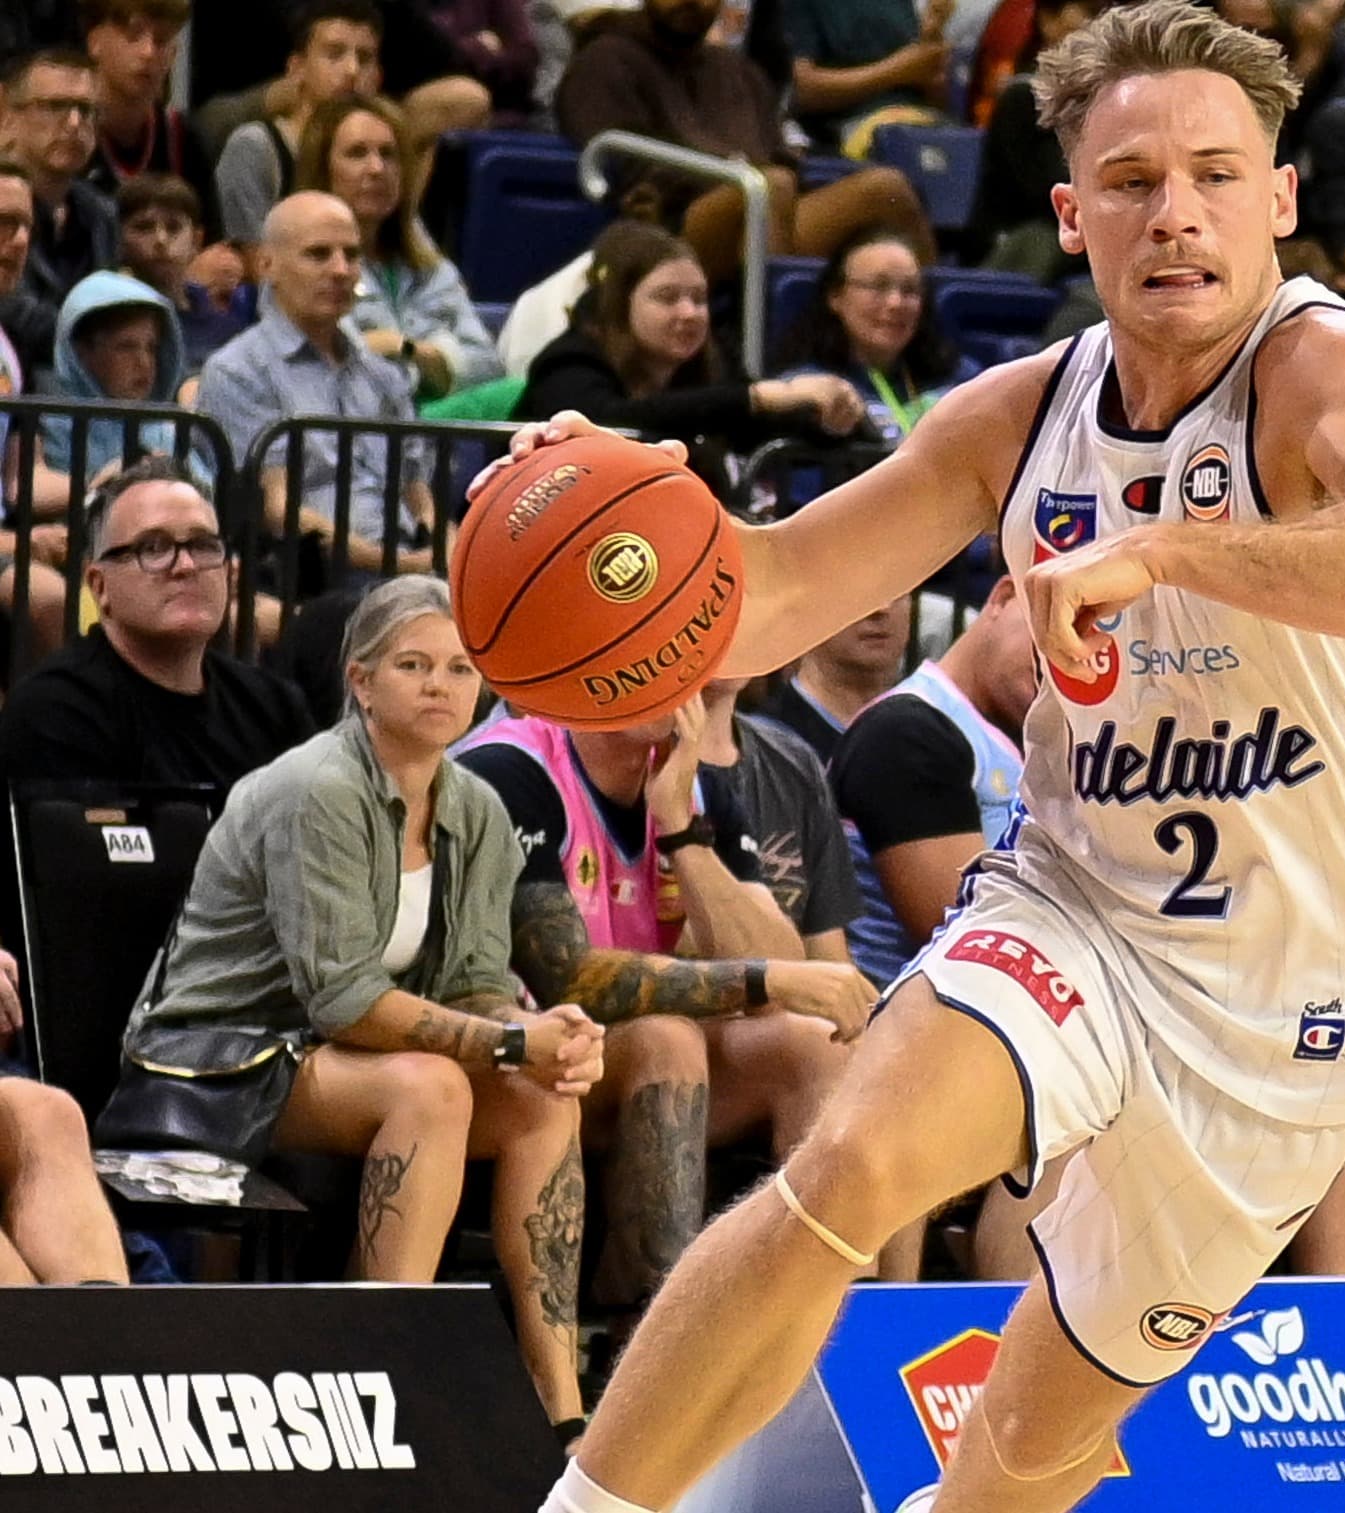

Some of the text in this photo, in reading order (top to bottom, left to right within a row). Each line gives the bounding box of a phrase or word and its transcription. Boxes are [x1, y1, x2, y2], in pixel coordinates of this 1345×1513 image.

[1192, 467, 1222, 499] NBL
[583, 557, 736, 706] SPALDING
[1075, 706, 1326, 806] delaide
[109, 833, 146, 855] A84
[1154, 811, 1232, 920] 2
[955, 949, 1059, 1020] FITNESS
[963, 934, 1075, 1003] REVO
[1303, 998, 1342, 1016] South
[1154, 1313, 1200, 1341] NBL
[1276, 1461, 1341, 1483] Natural
